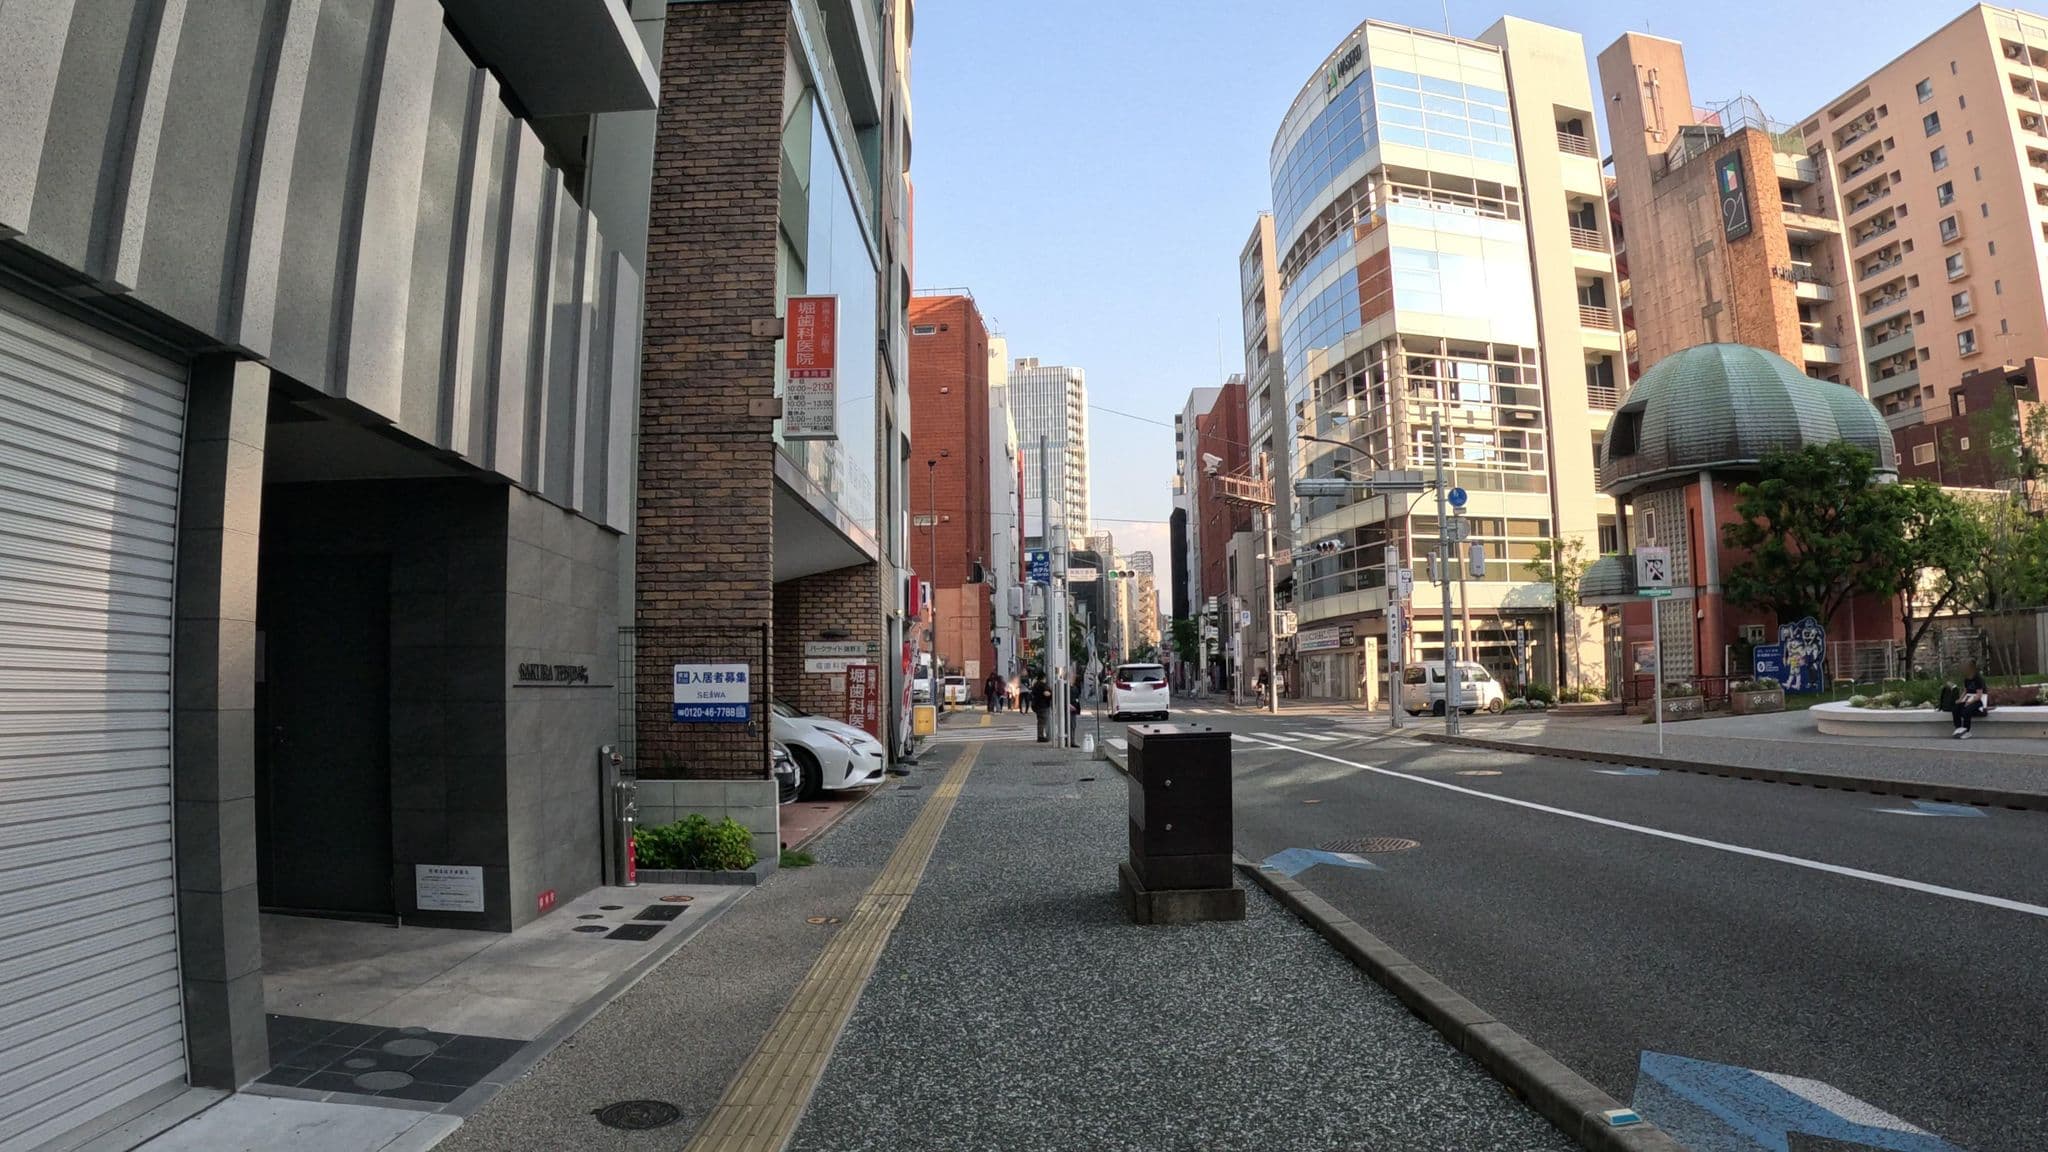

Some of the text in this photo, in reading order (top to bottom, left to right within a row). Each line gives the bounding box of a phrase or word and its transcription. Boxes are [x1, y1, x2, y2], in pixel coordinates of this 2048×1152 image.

[796, 301, 816, 366] 堀歯科医院
[518, 662, 553, 681] SAKURA
[691, 671, 747, 684] 入居者募集
[697, 690, 727, 699] SEIWA
